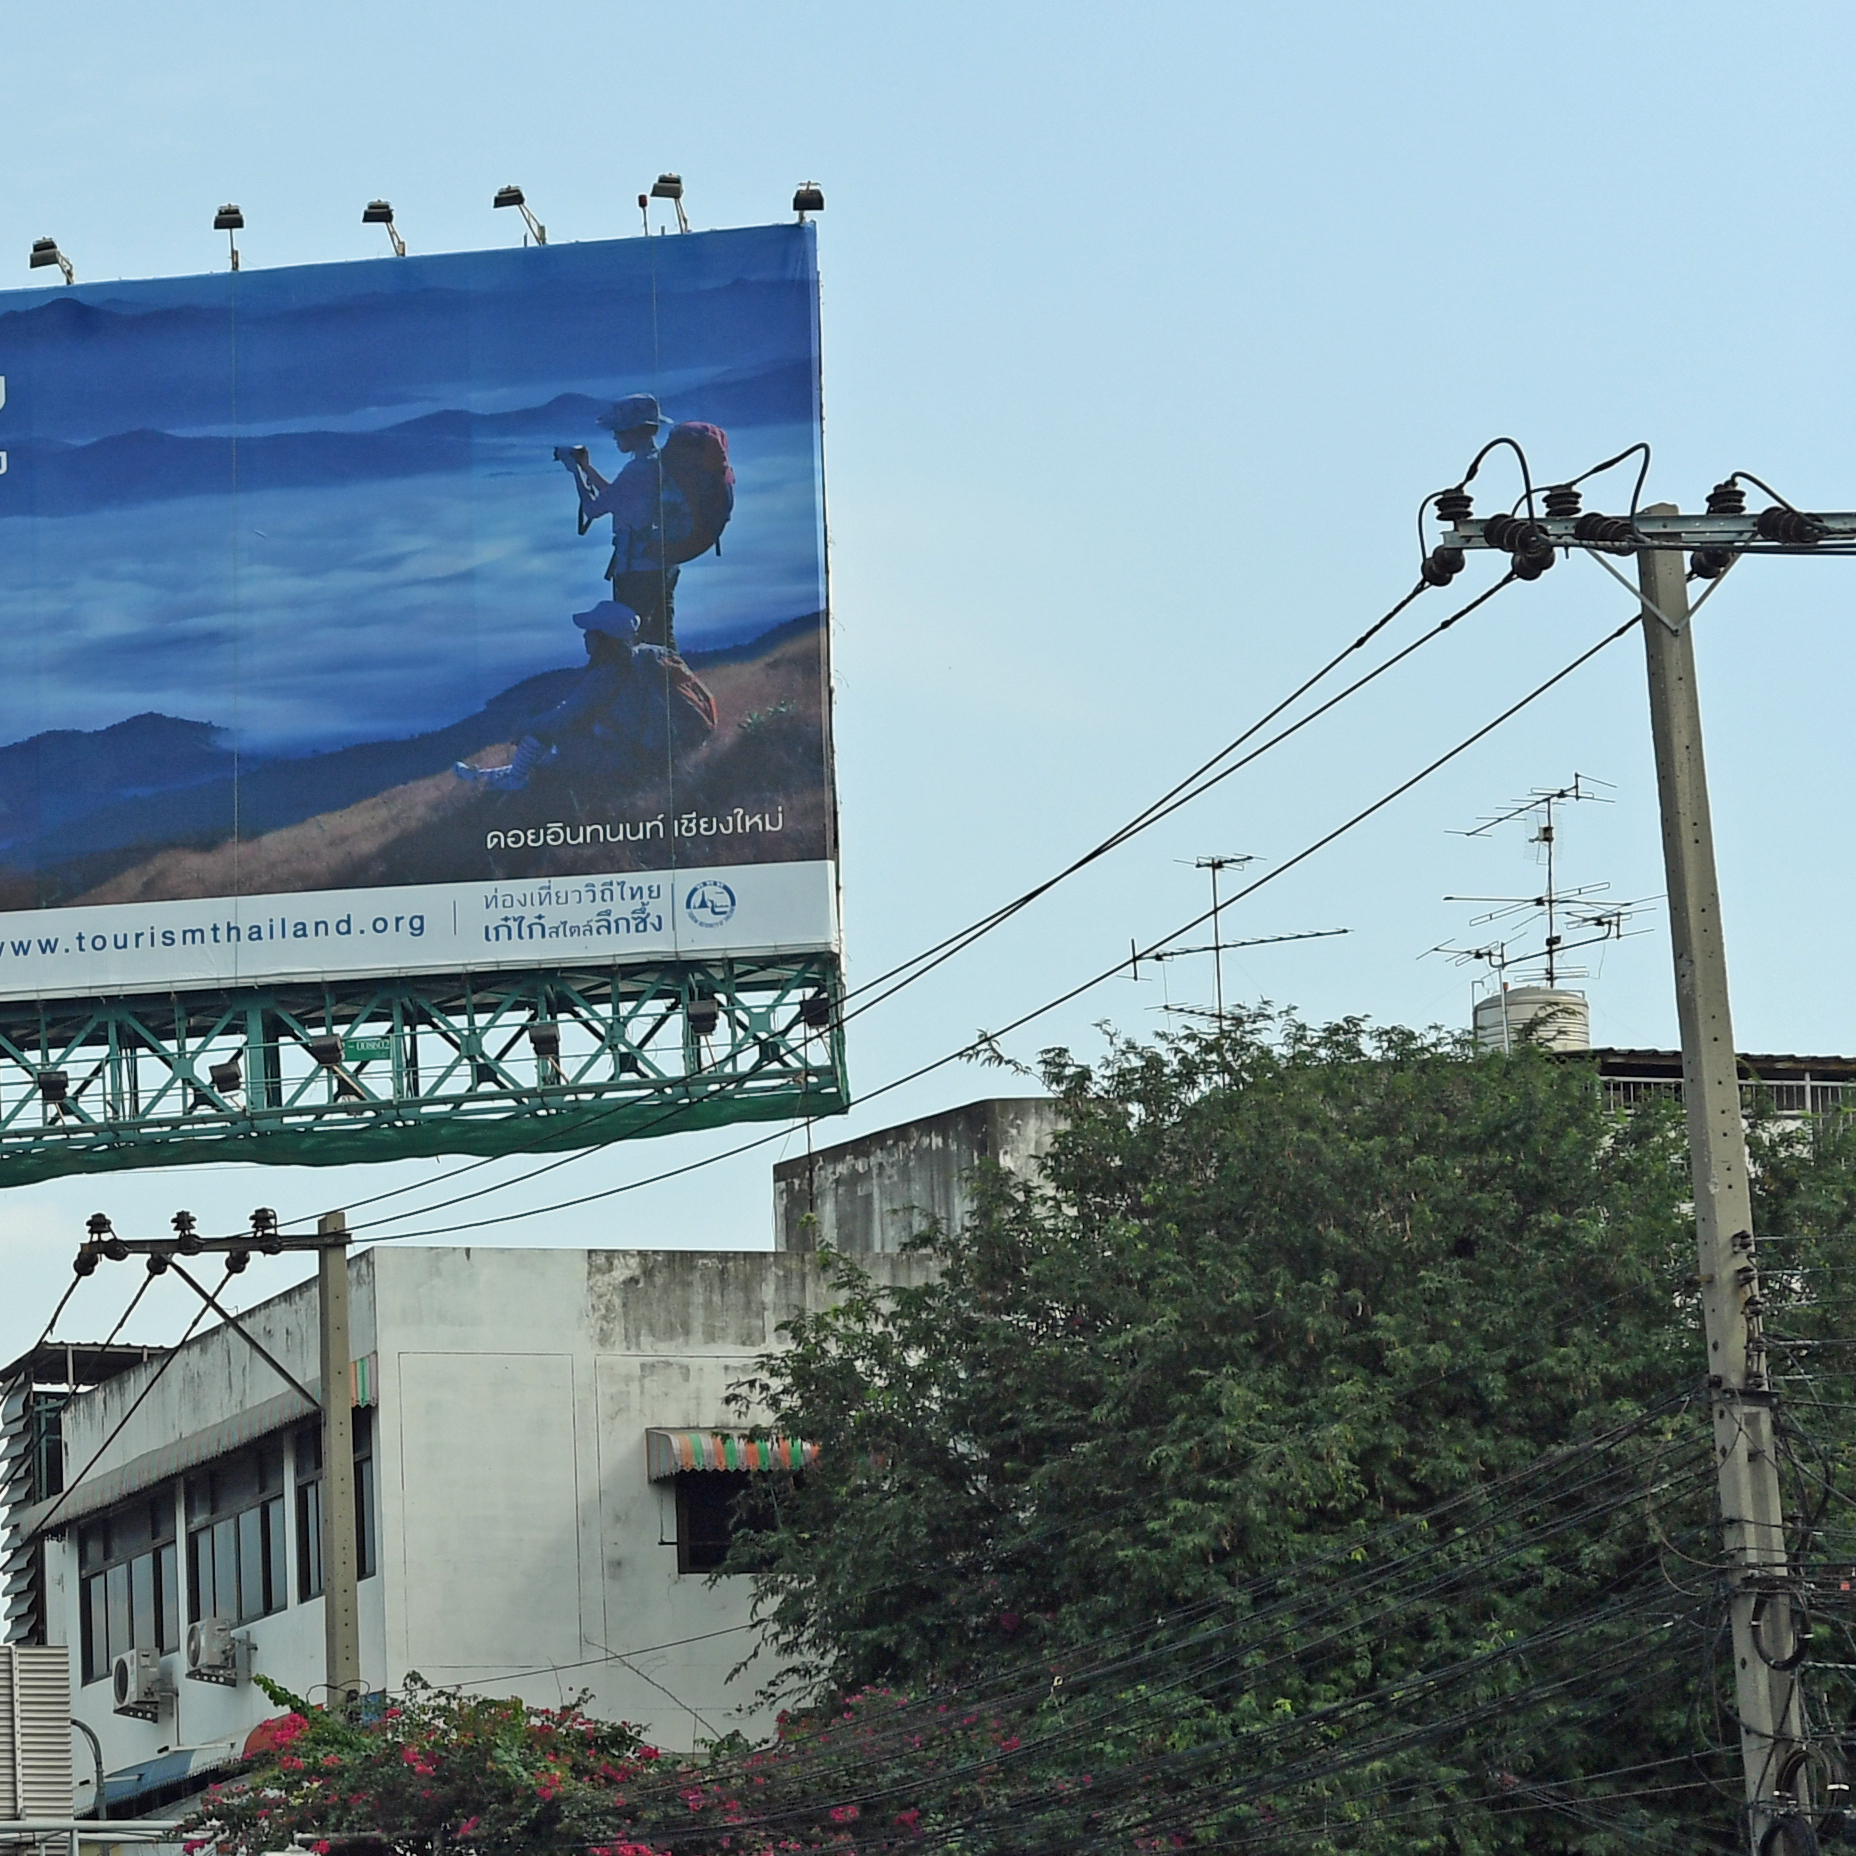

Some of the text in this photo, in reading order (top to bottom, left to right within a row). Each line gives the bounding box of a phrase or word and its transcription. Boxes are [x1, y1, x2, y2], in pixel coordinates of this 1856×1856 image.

[485, 806, 784, 850] ดอยอินทนนท์ เชียงใหม่
[483, 879, 662, 911] ท่องเที่ยววิถีไทย
